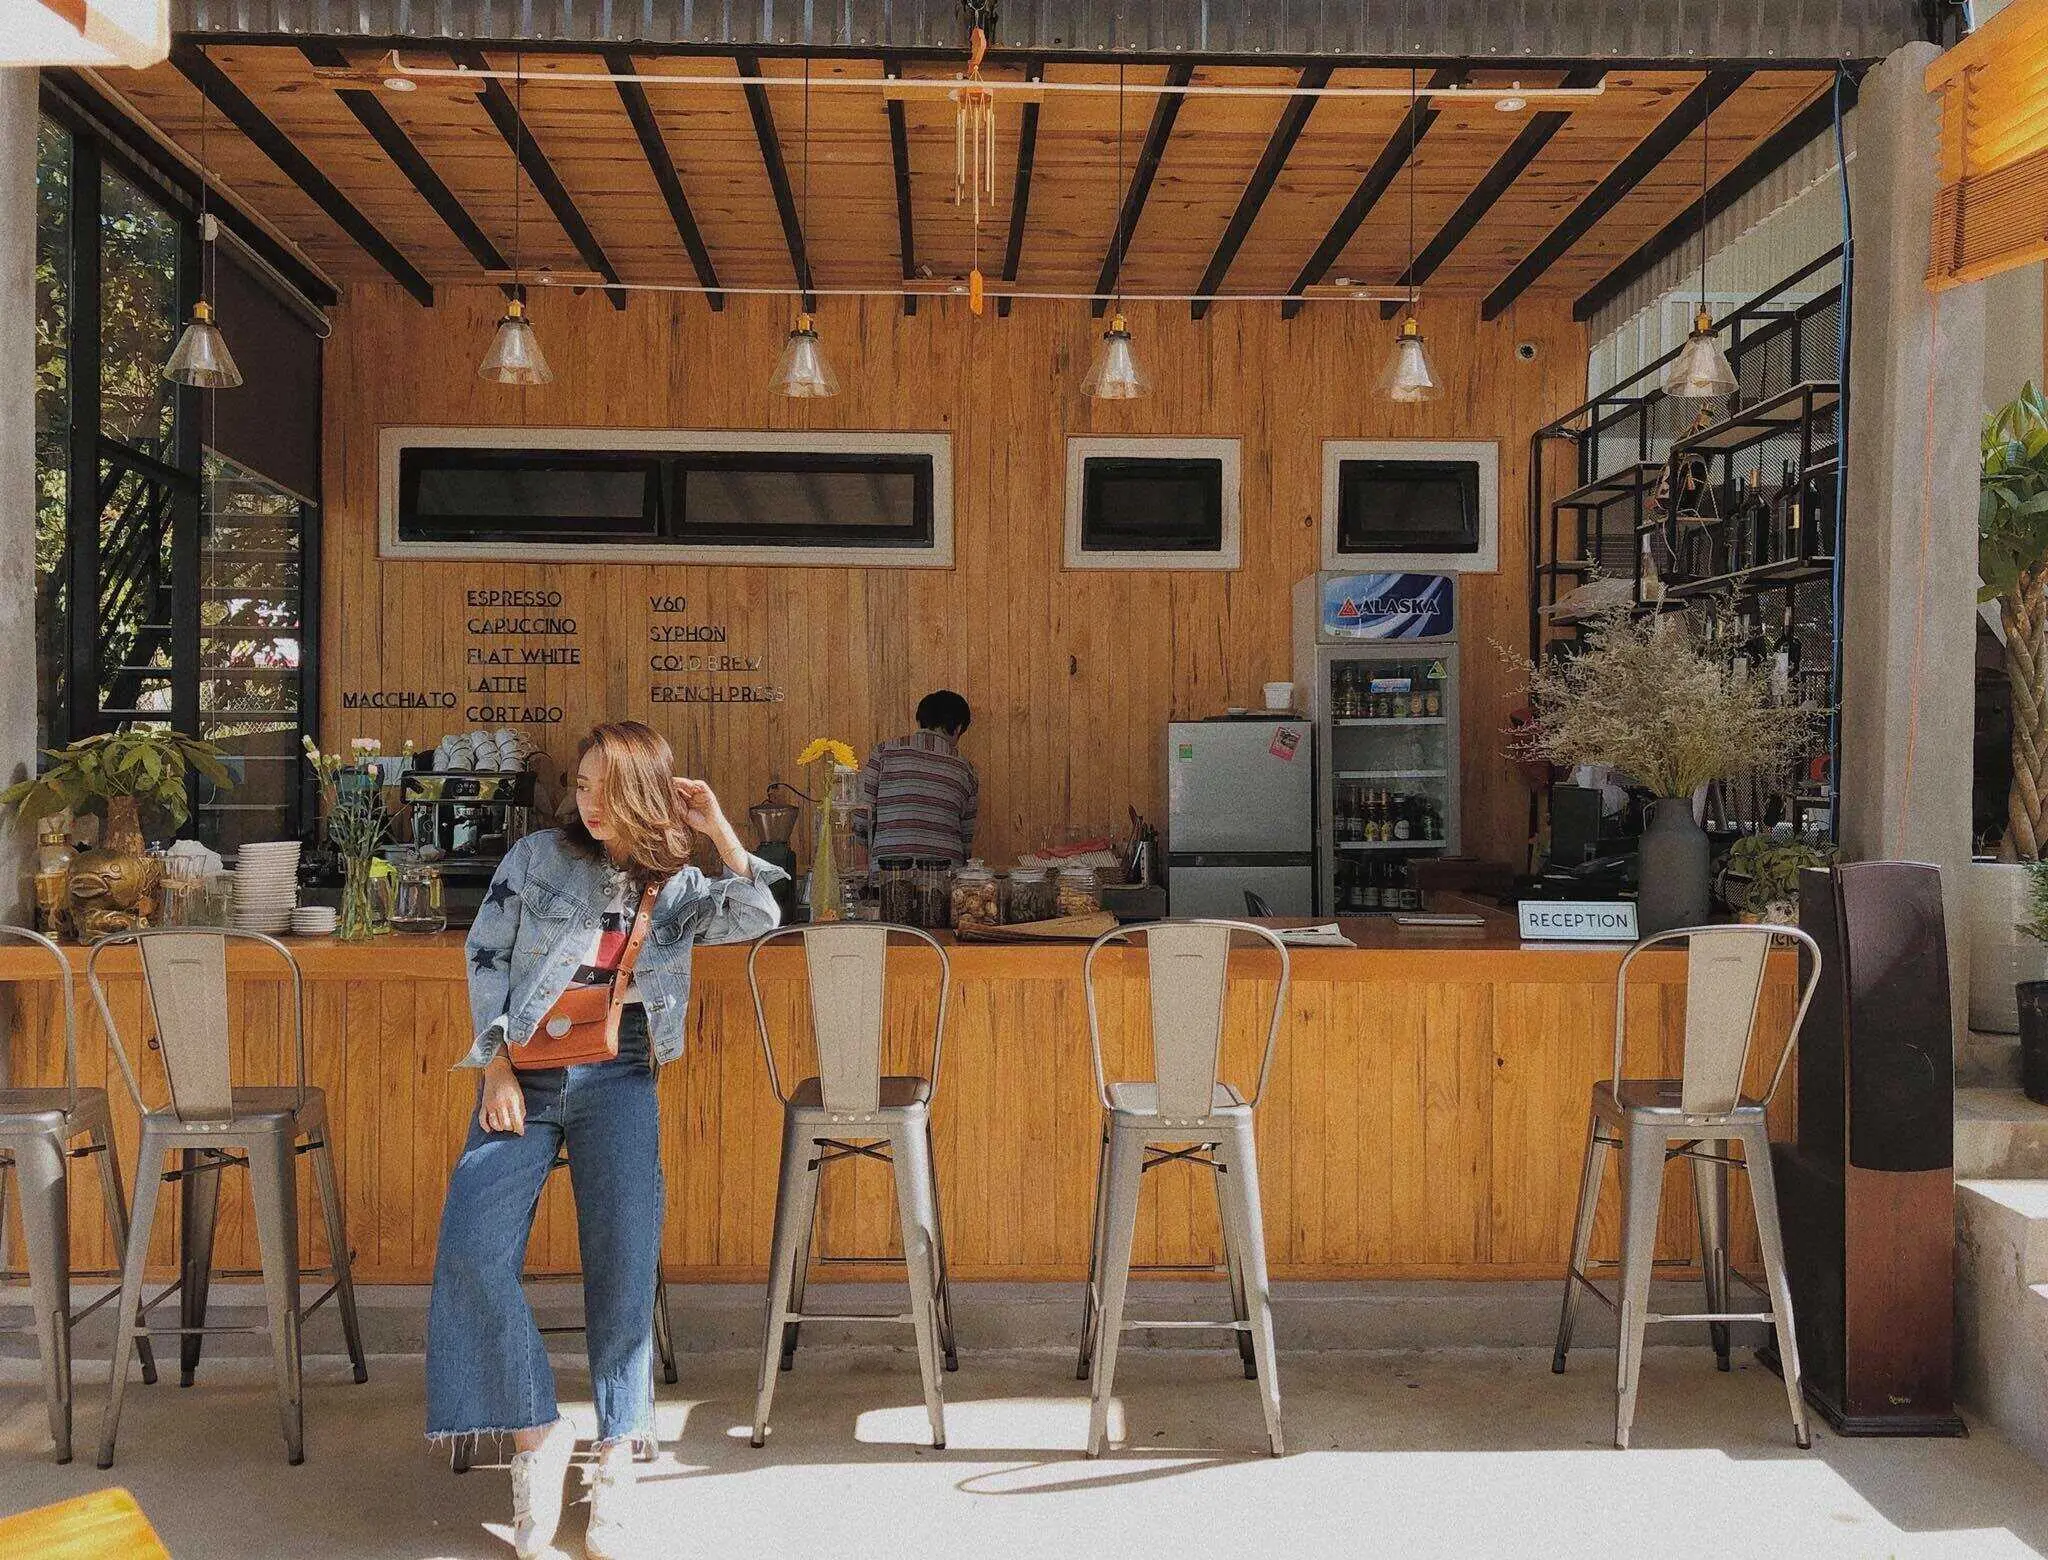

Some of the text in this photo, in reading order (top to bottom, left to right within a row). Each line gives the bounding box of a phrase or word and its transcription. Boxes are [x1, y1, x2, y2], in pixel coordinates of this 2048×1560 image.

[467, 590, 562, 606] ESPRESSO
[650, 596, 686, 612] V60
[1360, 598, 1440, 615] ALASKA
[467, 618, 577, 634] CAPUCCINO
[650, 626, 727, 642] SYPHON
[467, 648, 581, 664] FLAT WHITE
[707, 655, 764, 671] BREW
[468, 677, 527, 693] LATTE
[343, 692, 457, 708] MACCHIATO
[650, 686, 786, 702] FRENCH PRESS
[467, 706, 563, 722] CORTADO
[1529, 912, 1628, 928] RECEPTION
